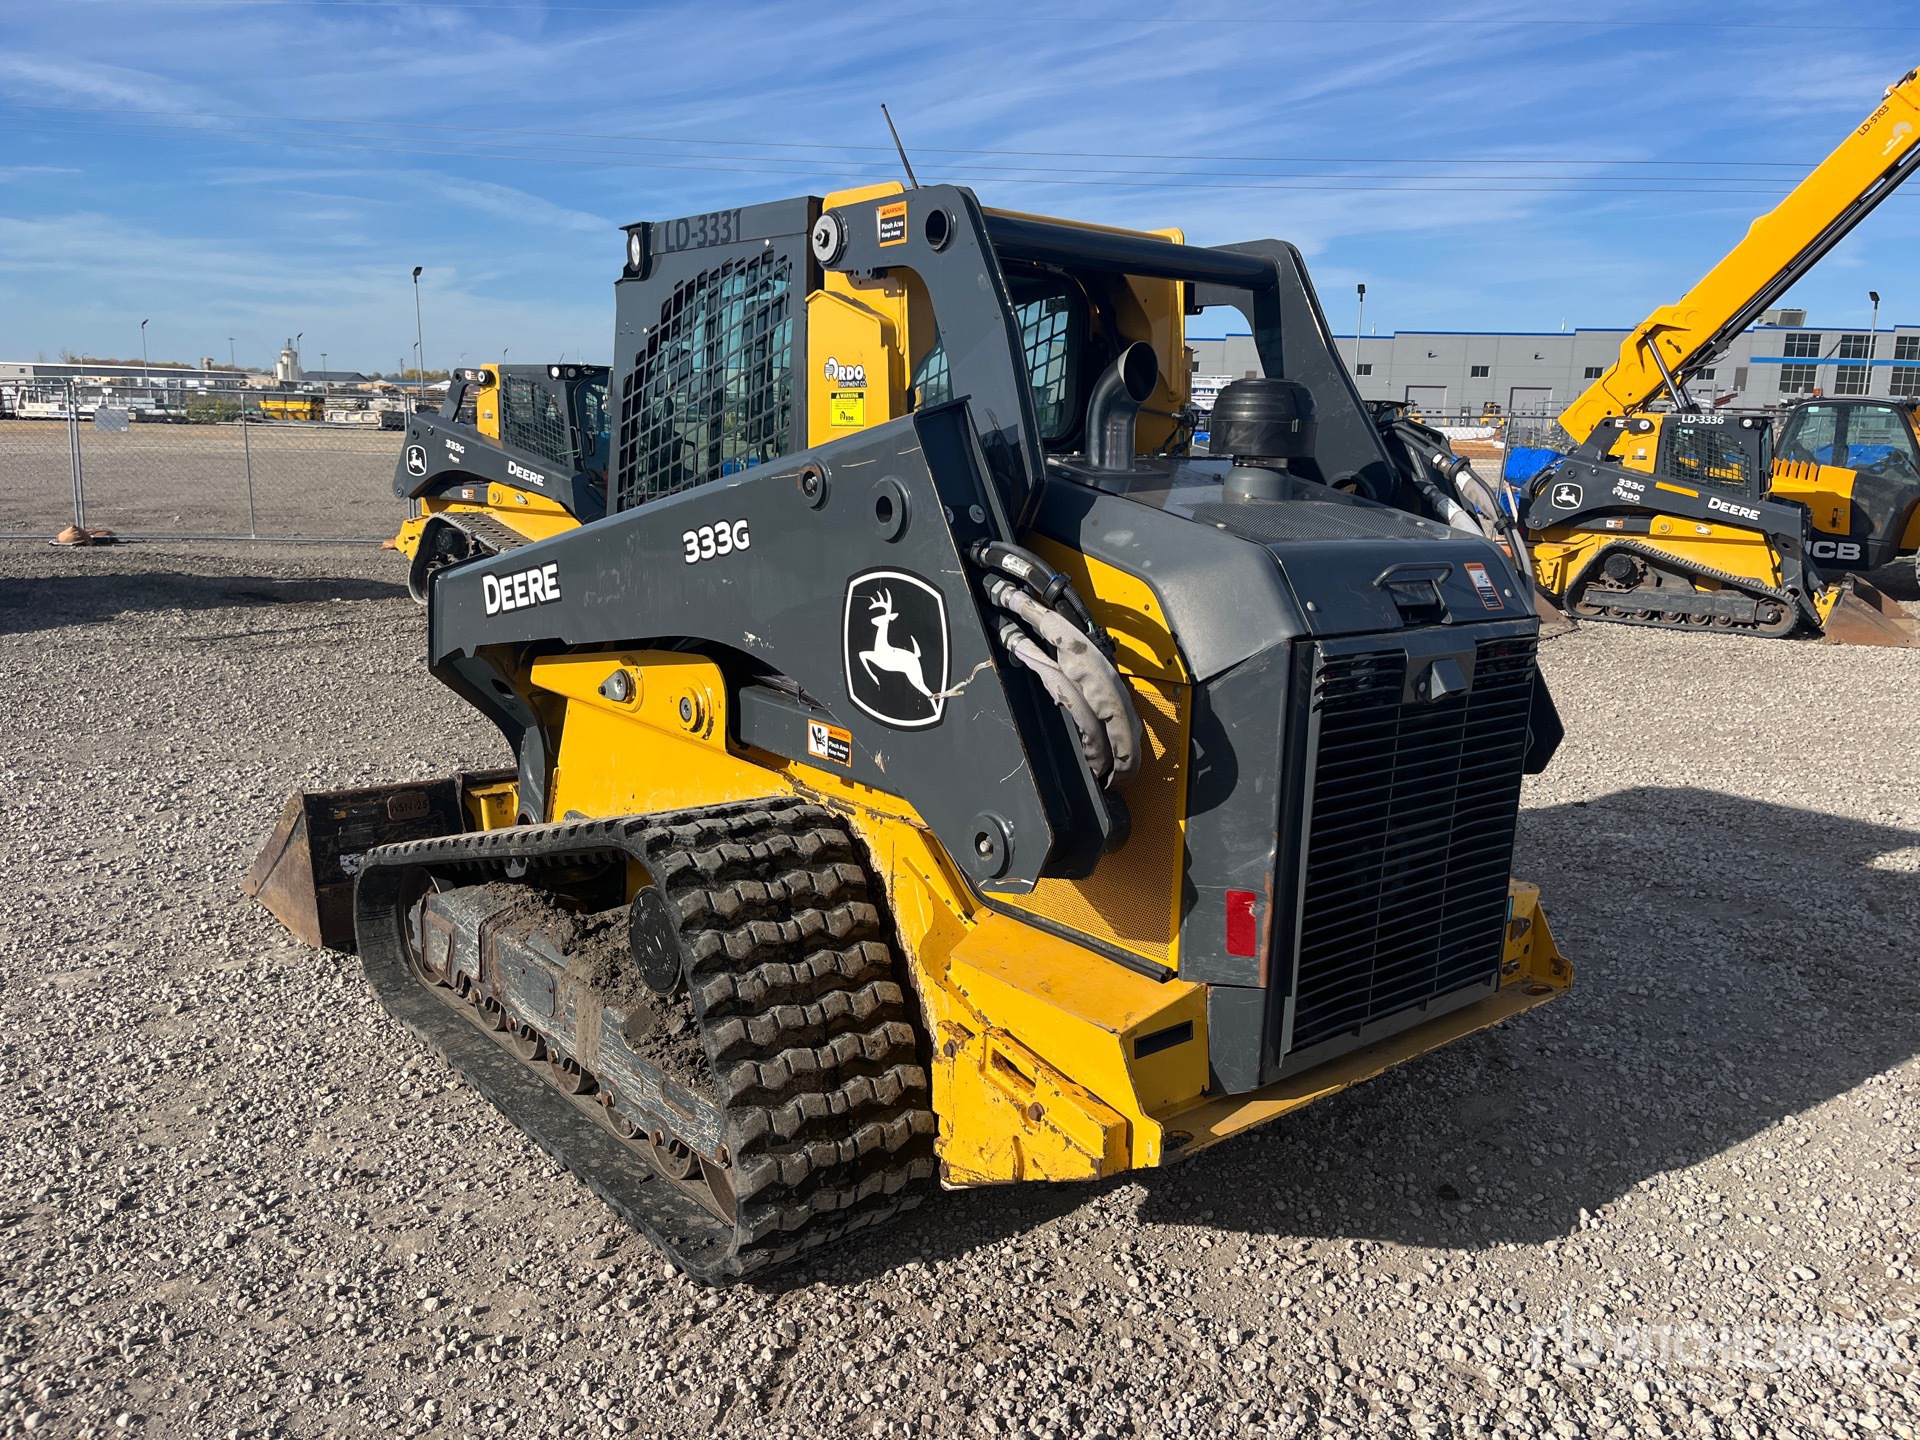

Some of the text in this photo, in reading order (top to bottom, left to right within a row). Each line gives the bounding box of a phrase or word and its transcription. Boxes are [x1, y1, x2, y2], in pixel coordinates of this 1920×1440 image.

[665, 208, 743, 252] LD-3331
[881, 222, 893, 230] Pinch
[838, 365, 864, 381] RDO
[1681, 414, 1725, 425] LD-3336
[445, 438, 465, 454] 333G
[507, 460, 545, 487] DEERE
[1617, 478, 1645, 492] 333G
[1621, 490, 1641, 501] RDO
[1707, 496, 1761, 521] DEERE
[682, 519, 751, 564] 333G
[482, 563, 561, 615] DEERE
